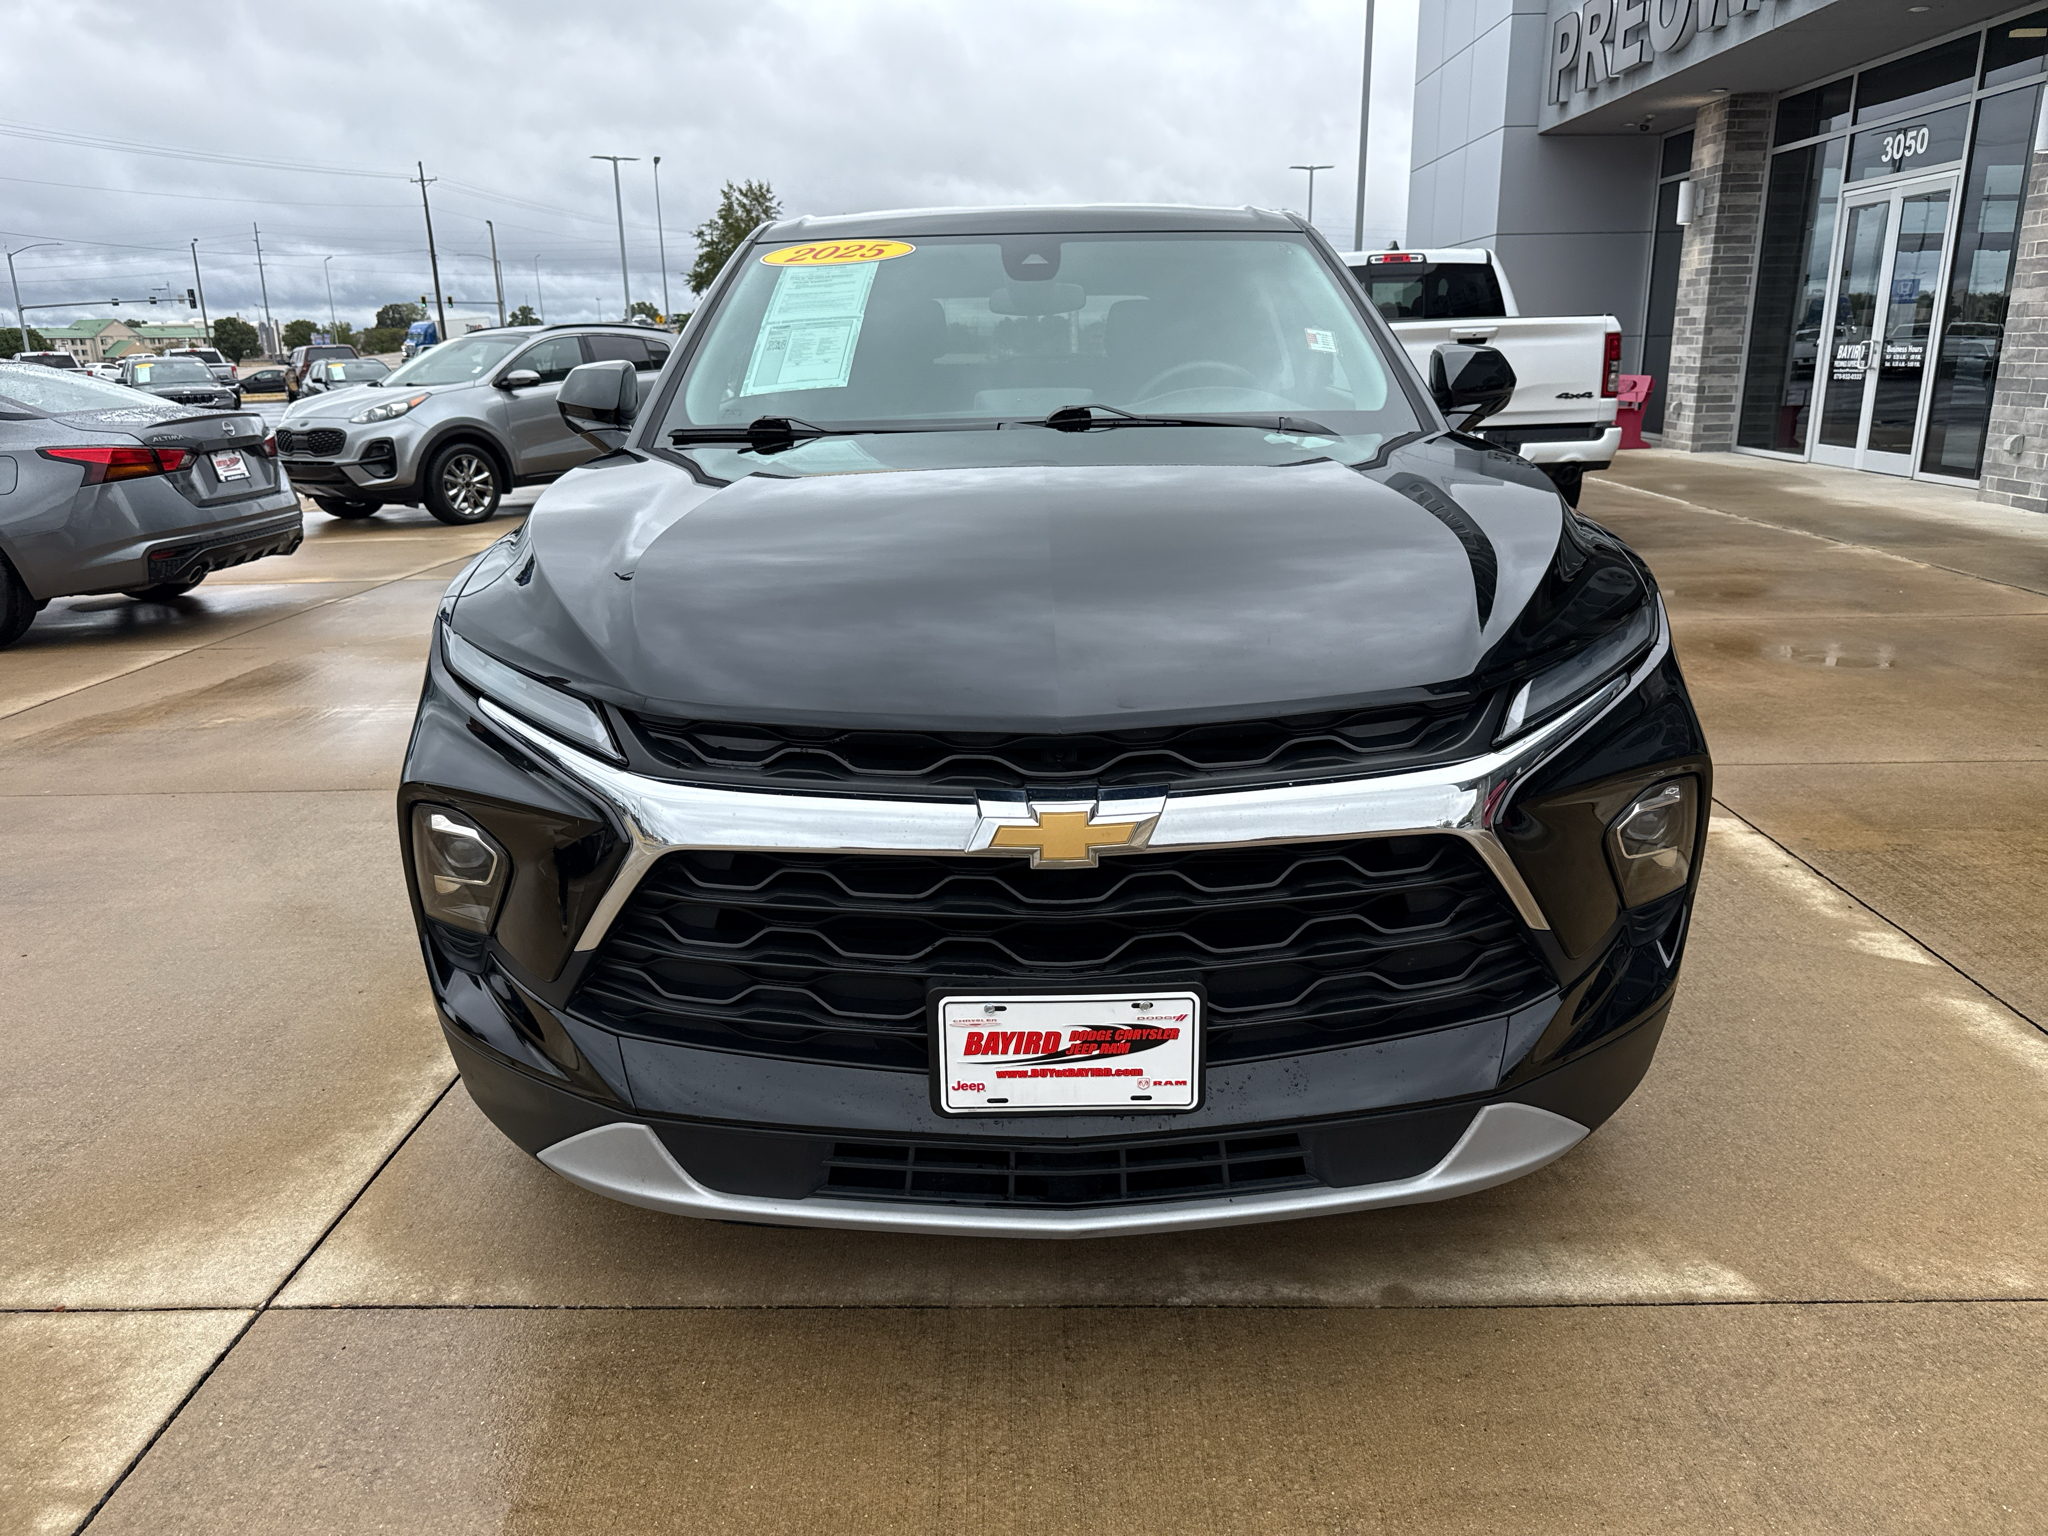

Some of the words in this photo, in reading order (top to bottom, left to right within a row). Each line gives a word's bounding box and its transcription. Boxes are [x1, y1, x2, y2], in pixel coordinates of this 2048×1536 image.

[1881, 127, 1929, 163] 3050
[784, 243, 892, 262] 2025
[1886, 345, 1907, 353] Business
[1908, 345, 1923, 353] Hours
[152, 434, 185, 443] ALTIMA
[1069, 1029, 1113, 1042] DODGE
[1114, 1027, 1180, 1040] CHRYSLER
[963, 1031, 1062, 1056] BAYIRD
[1065, 1043, 1098, 1055] JEEP
[1099, 1042, 1131, 1054] RAM
[995, 1067, 1144, 1079] www.BUYatBAYIRD.com
[951, 1080, 986, 1093] Jeep
